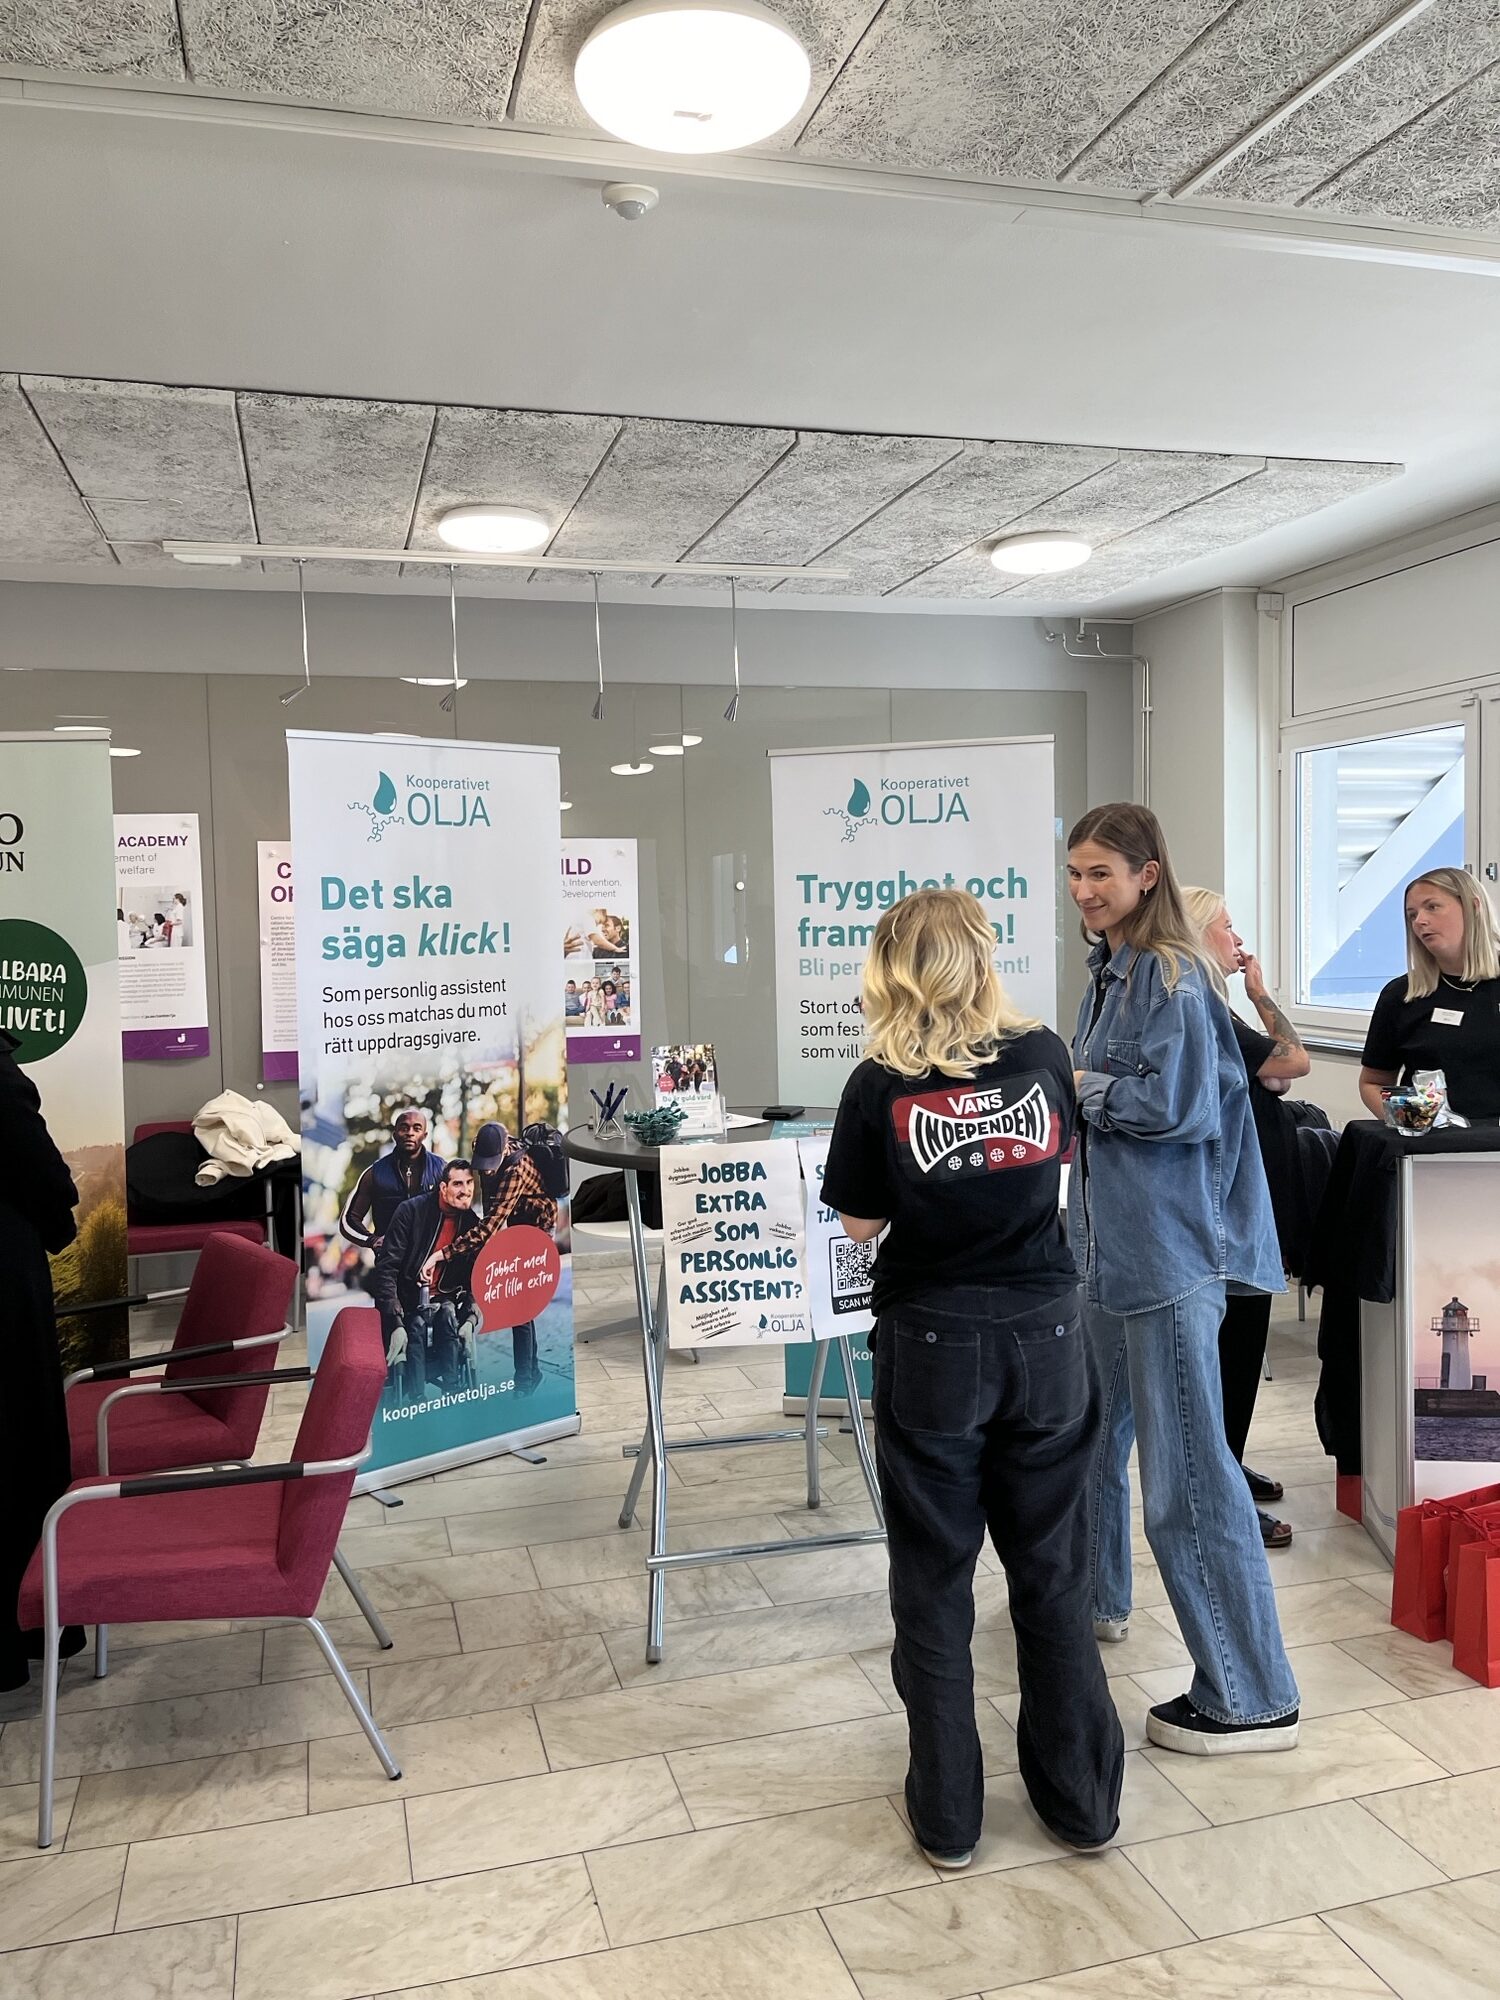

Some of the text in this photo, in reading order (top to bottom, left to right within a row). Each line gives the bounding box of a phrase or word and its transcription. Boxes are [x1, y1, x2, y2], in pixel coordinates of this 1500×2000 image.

[406, 774, 490, 791] Kooperativet
[881, 776, 970, 791] Kooperativet
[408, 792, 490, 827] OLJA
[881, 792, 970, 825] OLJA
[117, 835, 188, 848] ACADEMY
[0, 851, 24, 872] N
[120, 866, 155, 875] welfare
[321, 875, 452, 910] Det ska
[966, 867, 1028, 900] och
[322, 926, 406, 968] säga
[418, 922, 511, 956] klick!
[0, 960, 66, 984] LBARA
[799, 958, 824, 976] Bli
[0, 984, 64, 1002] MUNEN
[322, 979, 506, 1004] Som personlig assistent
[324, 1002, 507, 1029] hos oss matchas du mot
[800, 1000, 838, 1014] Stort
[801, 1024, 834, 1036] som
[324, 1029, 480, 1055] rätt uppdragsgivare.
[801, 1044, 859, 1058] som vill
[946, 1088, 1004, 1115] VANS
[915, 1087, 1045, 1164] INDEPENDENT
[698, 1162, 767, 1184] JOBBA
[816, 1164, 826, 1180] S
[696, 1190, 767, 1214] EXTRA
[714, 1220, 760, 1242] SOM
[486, 1248, 548, 1285] Jobbet med
[484, 1270, 553, 1304] det lilla extra
[839, 1297, 861, 1310] SCAN
[771, 1319, 805, 1332] OLJA
[383, 1379, 515, 1423] kooperativetolja.se
